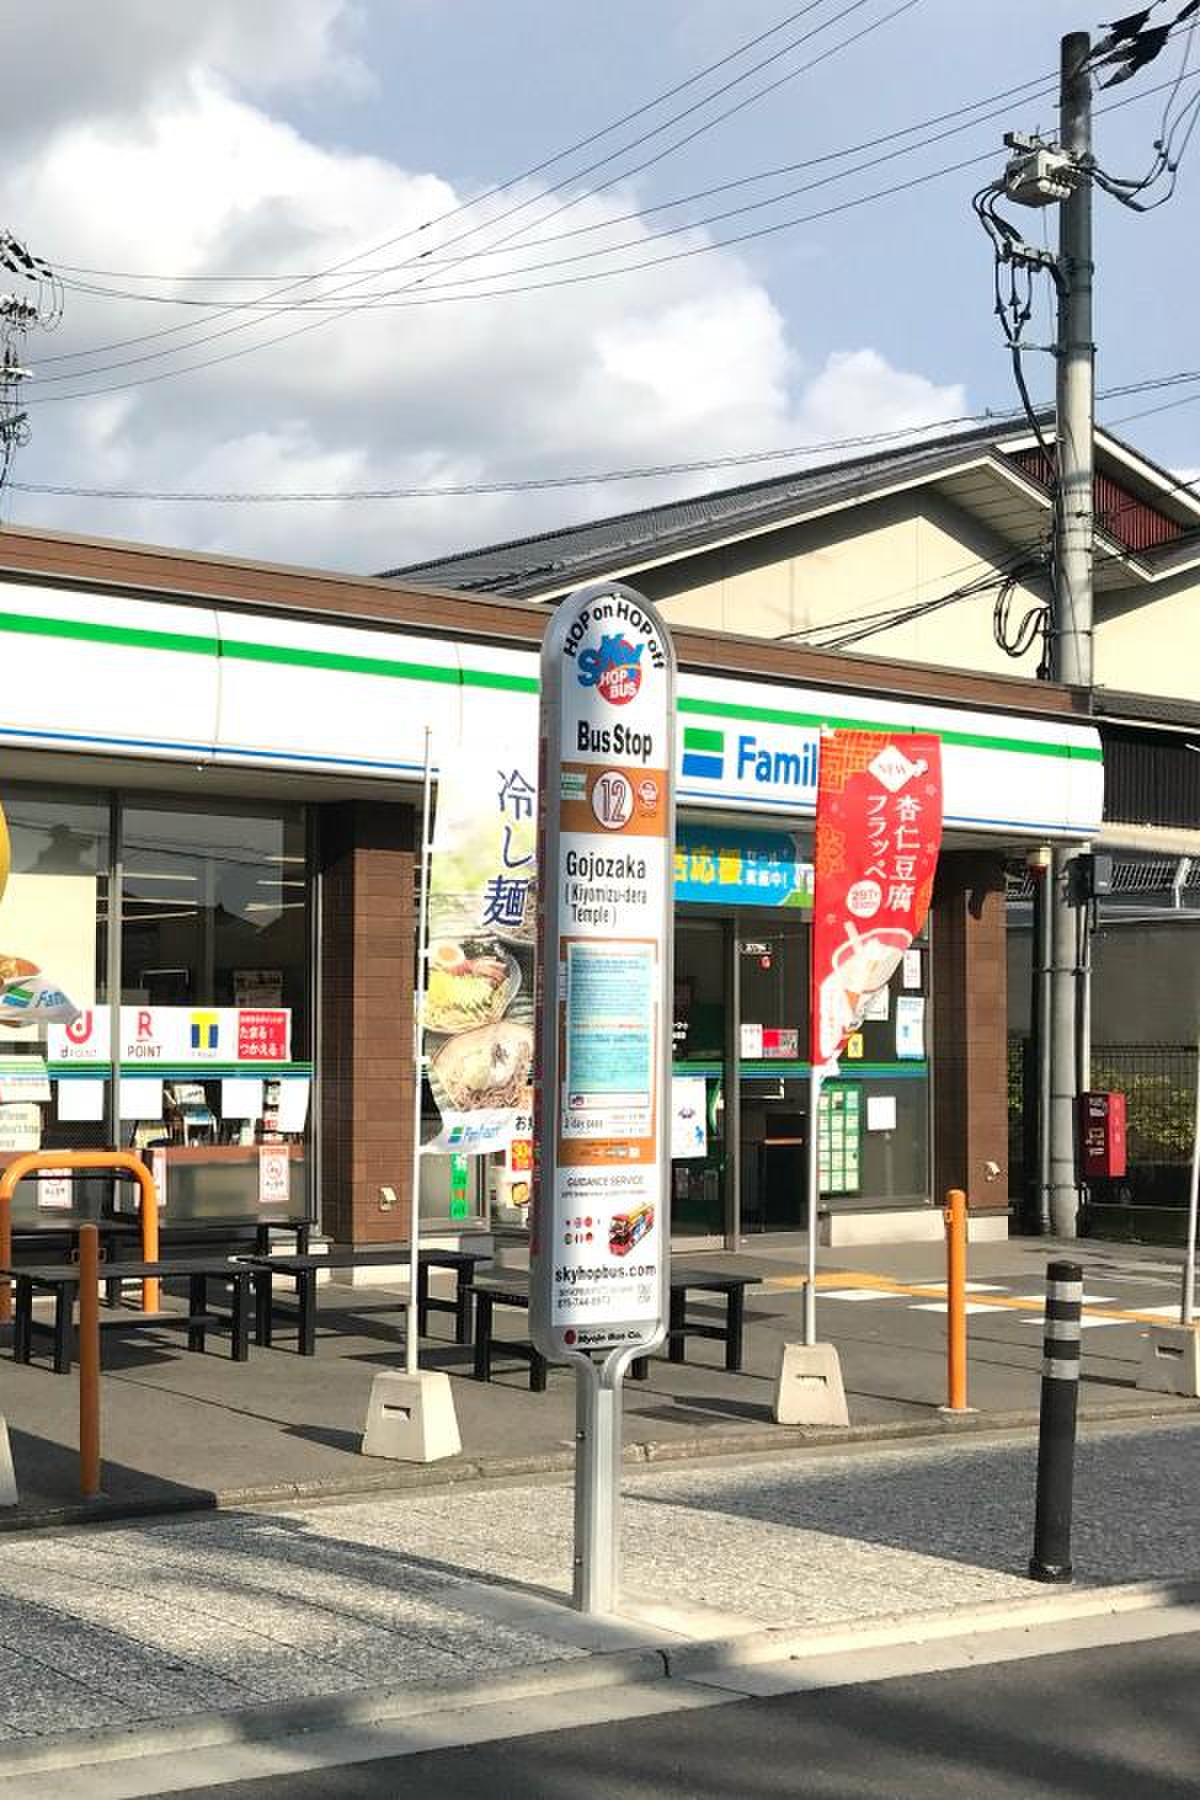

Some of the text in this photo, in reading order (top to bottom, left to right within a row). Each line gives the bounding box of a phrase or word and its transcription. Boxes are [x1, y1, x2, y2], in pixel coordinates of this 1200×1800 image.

[563, 611, 590, 657] HOP
[593, 605, 613, 621] on
[617, 602, 652, 635] HOP
[577, 633, 644, 688] SKY
[601, 670, 628, 686] HOP
[610, 681, 637, 699] BUS
[577, 720, 653, 762] Bus Stop
[737, 735, 817, 788] Famil
[600, 779, 626, 823] 12
[483, 768, 537, 928] 冷し麺
[864, 794, 889, 880] フラッペ
[885, 794, 923, 913] 杏仁豆腐
[566, 851, 646, 882] Gojozaka
[35, 989, 66, 1008] Fam
[127, 1045, 163, 1058] POINT
[555, 1264, 657, 1285] skyhopbus.com
